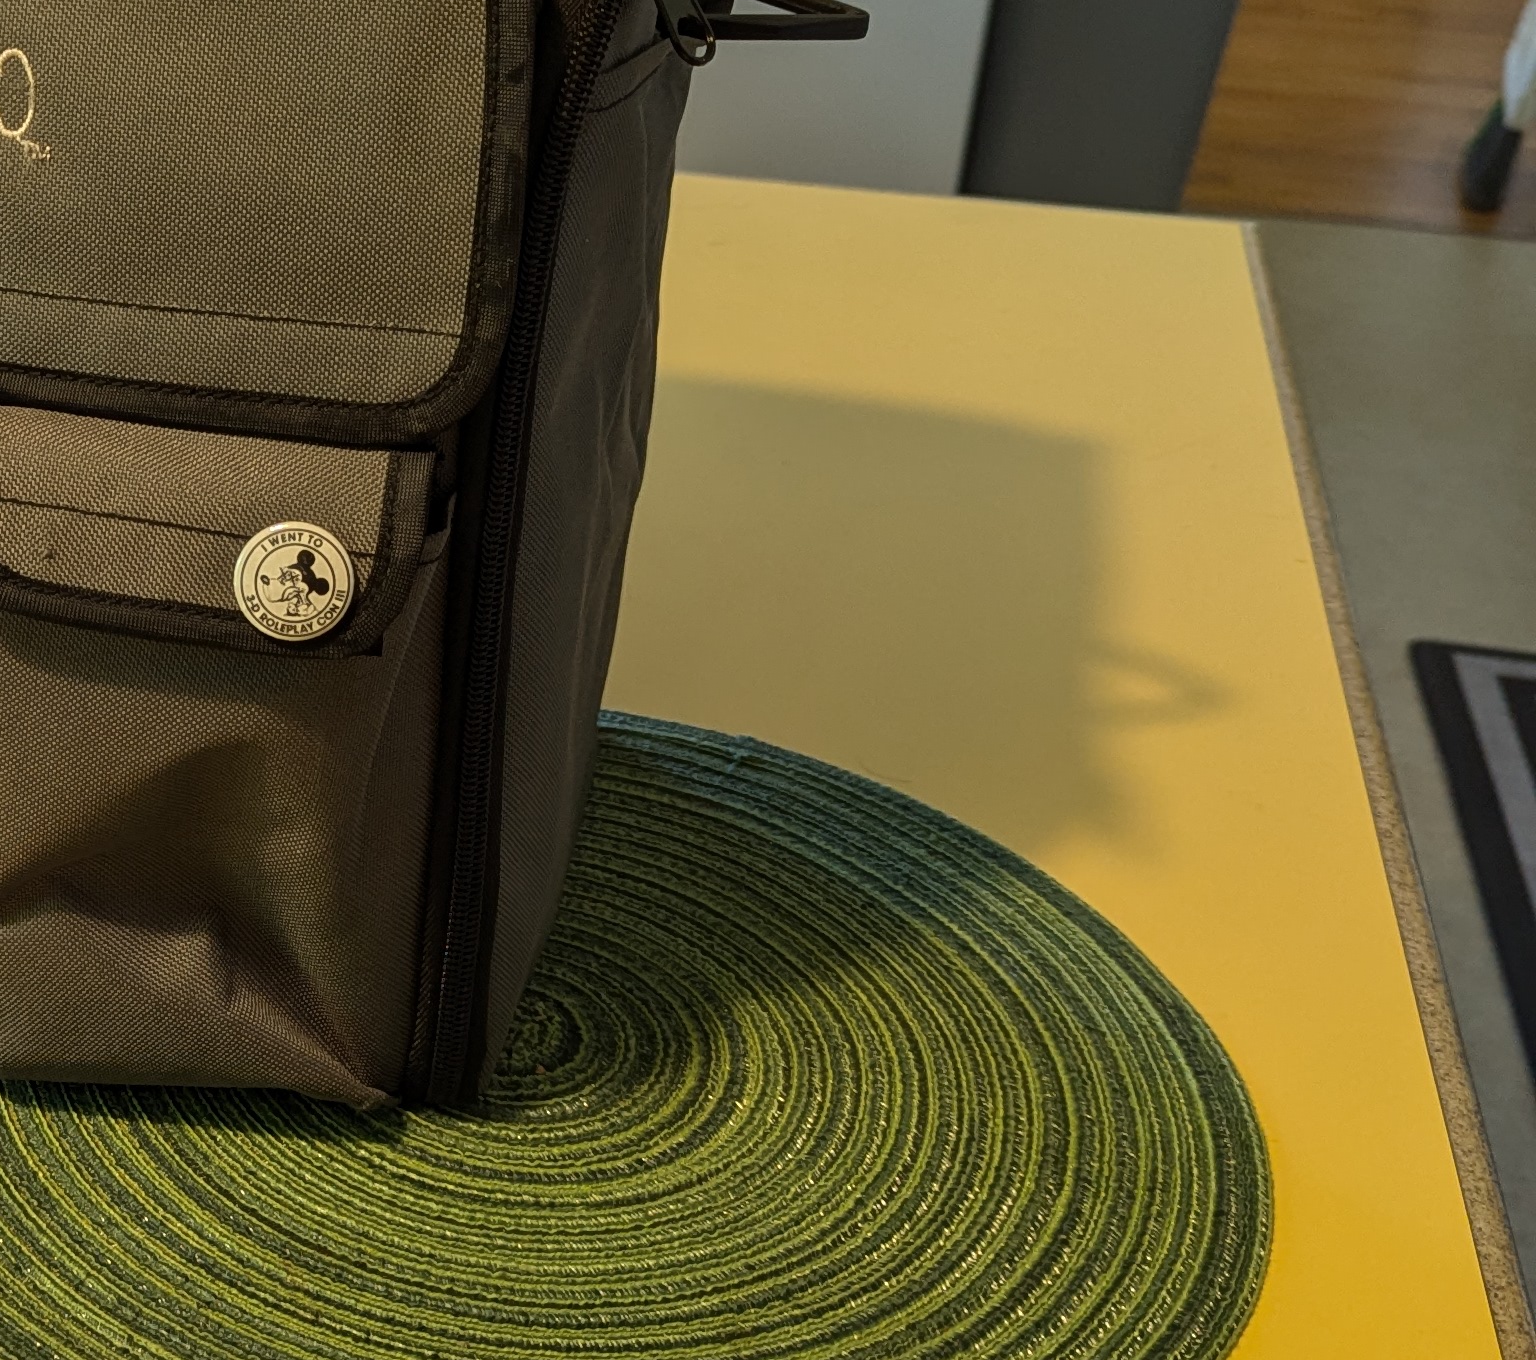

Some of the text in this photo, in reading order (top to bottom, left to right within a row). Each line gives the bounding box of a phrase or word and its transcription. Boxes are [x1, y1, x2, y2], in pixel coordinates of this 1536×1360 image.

[260, 532, 324, 553] I WENT TO
[246, 589, 347, 635] 3-D ROLEPLAY CON III
